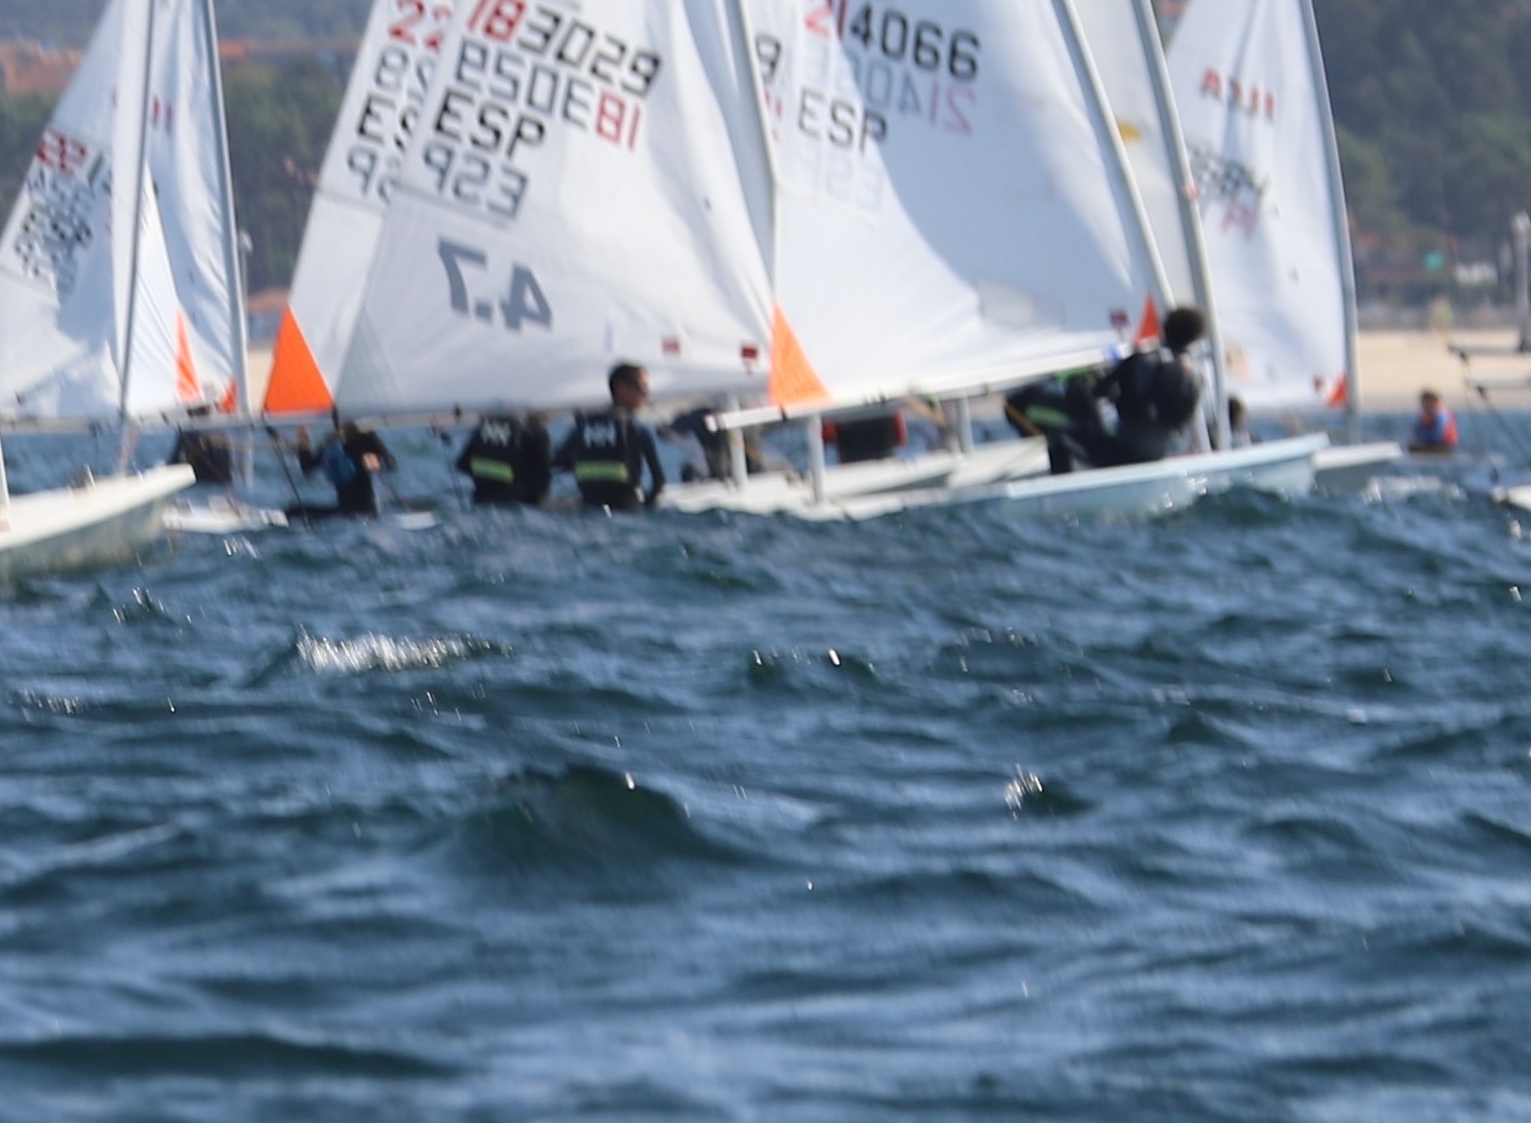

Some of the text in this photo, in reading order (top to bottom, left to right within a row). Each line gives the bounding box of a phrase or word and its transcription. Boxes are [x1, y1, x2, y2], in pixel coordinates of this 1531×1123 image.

[355, 88, 420, 154] ES
[432, 86, 546, 162] ESP
[798, 87, 888, 154] ESP
